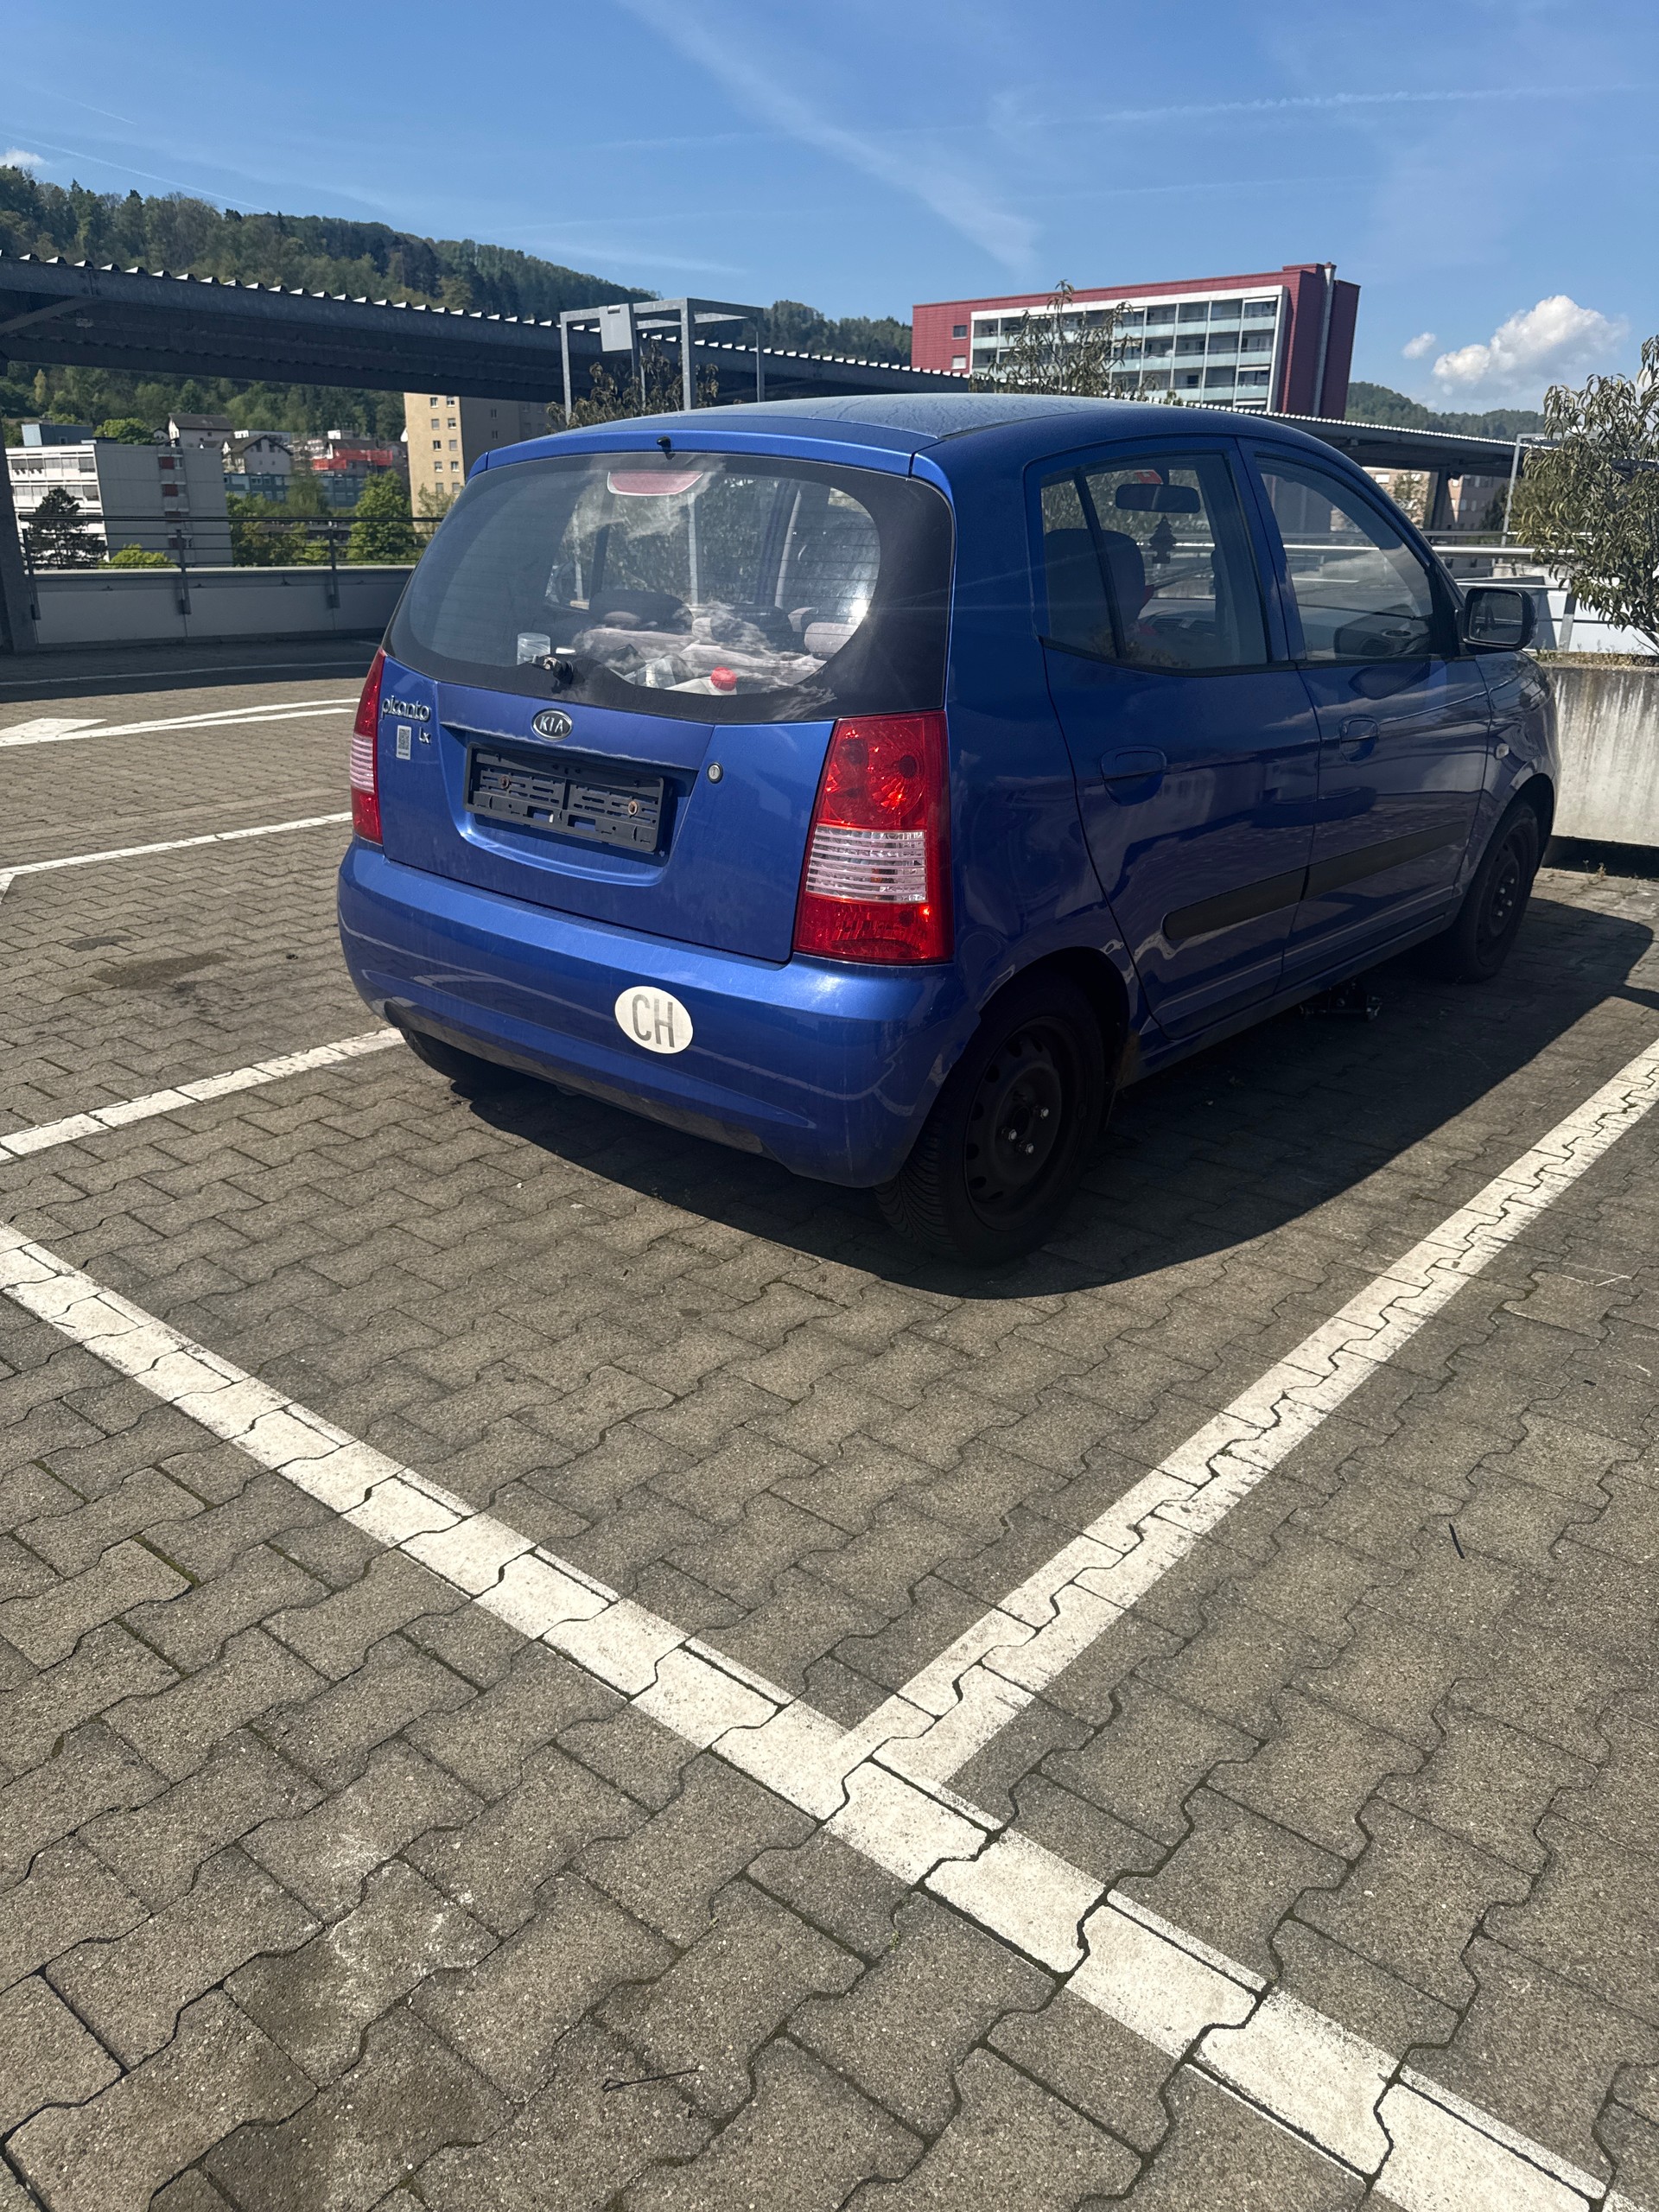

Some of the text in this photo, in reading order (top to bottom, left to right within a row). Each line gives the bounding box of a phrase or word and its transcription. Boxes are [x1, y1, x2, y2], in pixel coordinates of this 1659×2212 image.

[381, 695, 430, 721] picanto
[539, 716, 563, 733] KIA
[632, 994, 675, 1048] CH
